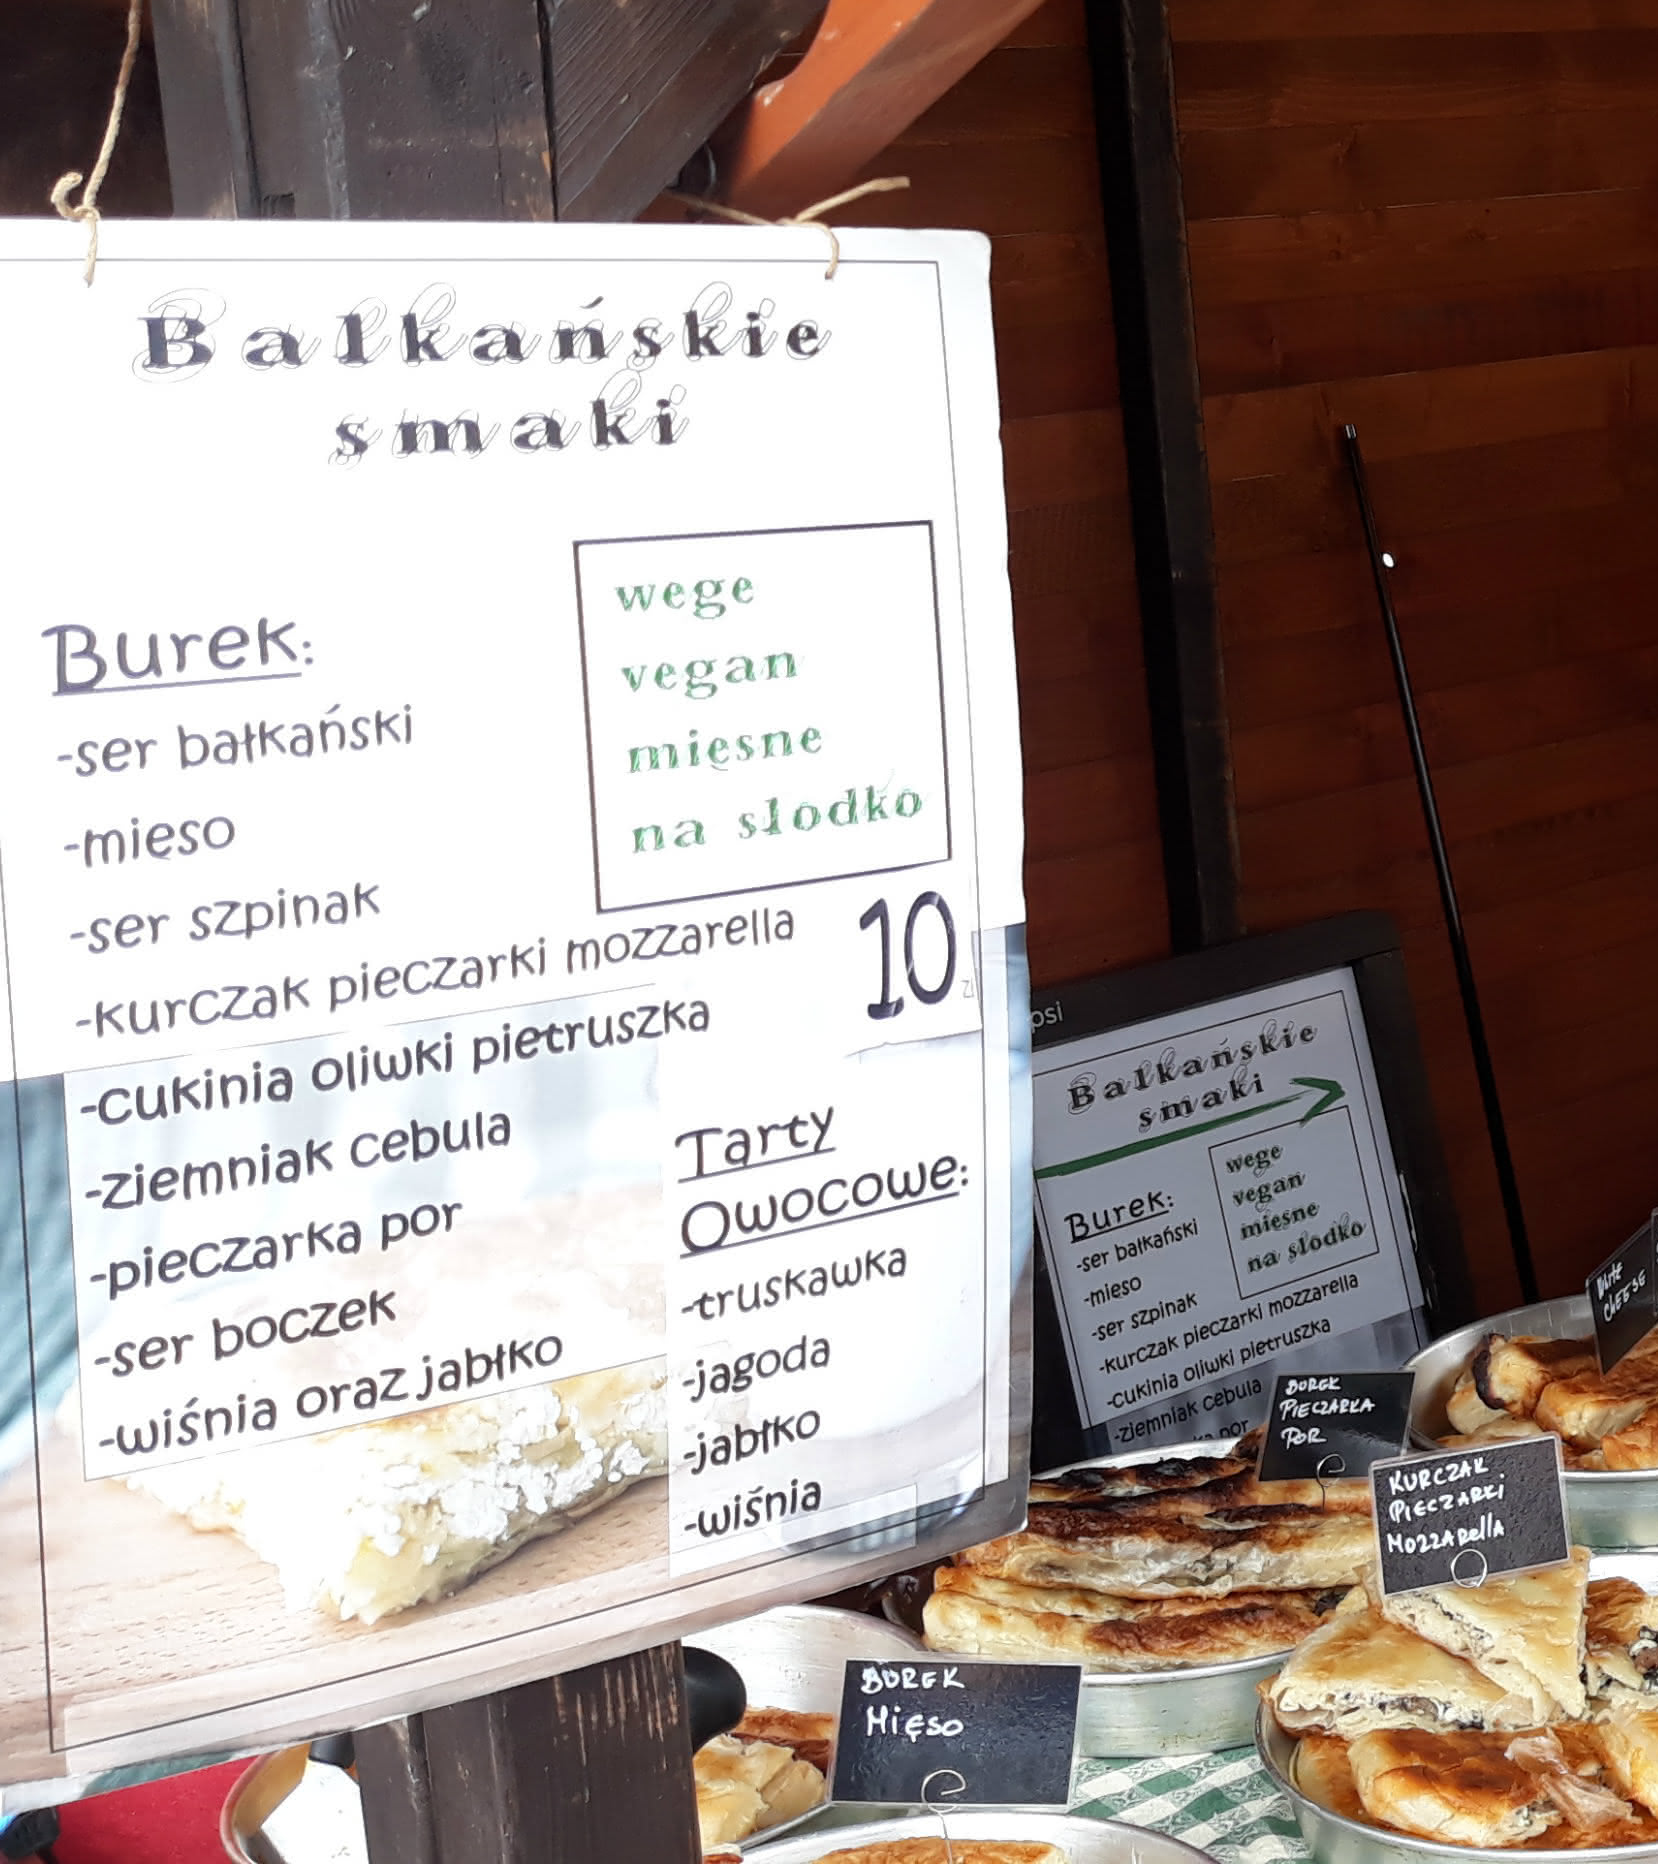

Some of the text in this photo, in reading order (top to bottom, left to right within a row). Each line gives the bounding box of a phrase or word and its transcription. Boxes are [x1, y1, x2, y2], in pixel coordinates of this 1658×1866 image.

[328, 368, 689, 469] smaki
[613, 576, 754, 620] wege
[41, 617, 313, 696] Burek:
[620, 651, 799, 700] vegan
[177, 703, 412, 769] bałkański
[632, 817, 706, 854] na
[189, 882, 380, 941] szpinak
[75, 907, 794, 1038] -kurczak pieczarki mozzarella
[859, 890, 957, 1020] 10
[1031, 1000, 1063, 1034] psi
[80, 1000, 710, 1126] -cukinia oliwki pietruszka
[1138, 1064, 1265, 1133] smaki
[85, 1111, 511, 1210] -ziemniak cebula
[675, 1106, 836, 1180] Tarty
[1225, 1144, 1284, 1178] wege
[680, 1155, 969, 1254] Owocowe:
[1063, 1191, 1175, 1244] Burek:
[1232, 1171, 1306, 1212] vegan
[90, 1201, 464, 1300] -pieczarka por
[1114, 1217, 1199, 1263] bałkański
[1247, 1252, 1280, 1275] na
[681, 1247, 907, 1321] -truskawka
[1130, 1291, 1198, 1329] szpinak
[1183, 1303, 1263, 1349] pieczarki
[1268, 1272, 1359, 1317] mozzarella
[212, 1288, 397, 1361] boczek
[1184, 1349, 1235, 1382] oliwki
[1240, 1317, 1331, 1365] pietruszka
[296, 1366, 409, 1419] oraz
[416, 1334, 564, 1402] jabłko
[682, 1335, 831, 1402] -jagoda
[1202, 1377, 1262, 1413] cebula
[1279, 1398, 1375, 1421] PIECZARKA
[1388, 1457, 1489, 1495] KURCZAK
